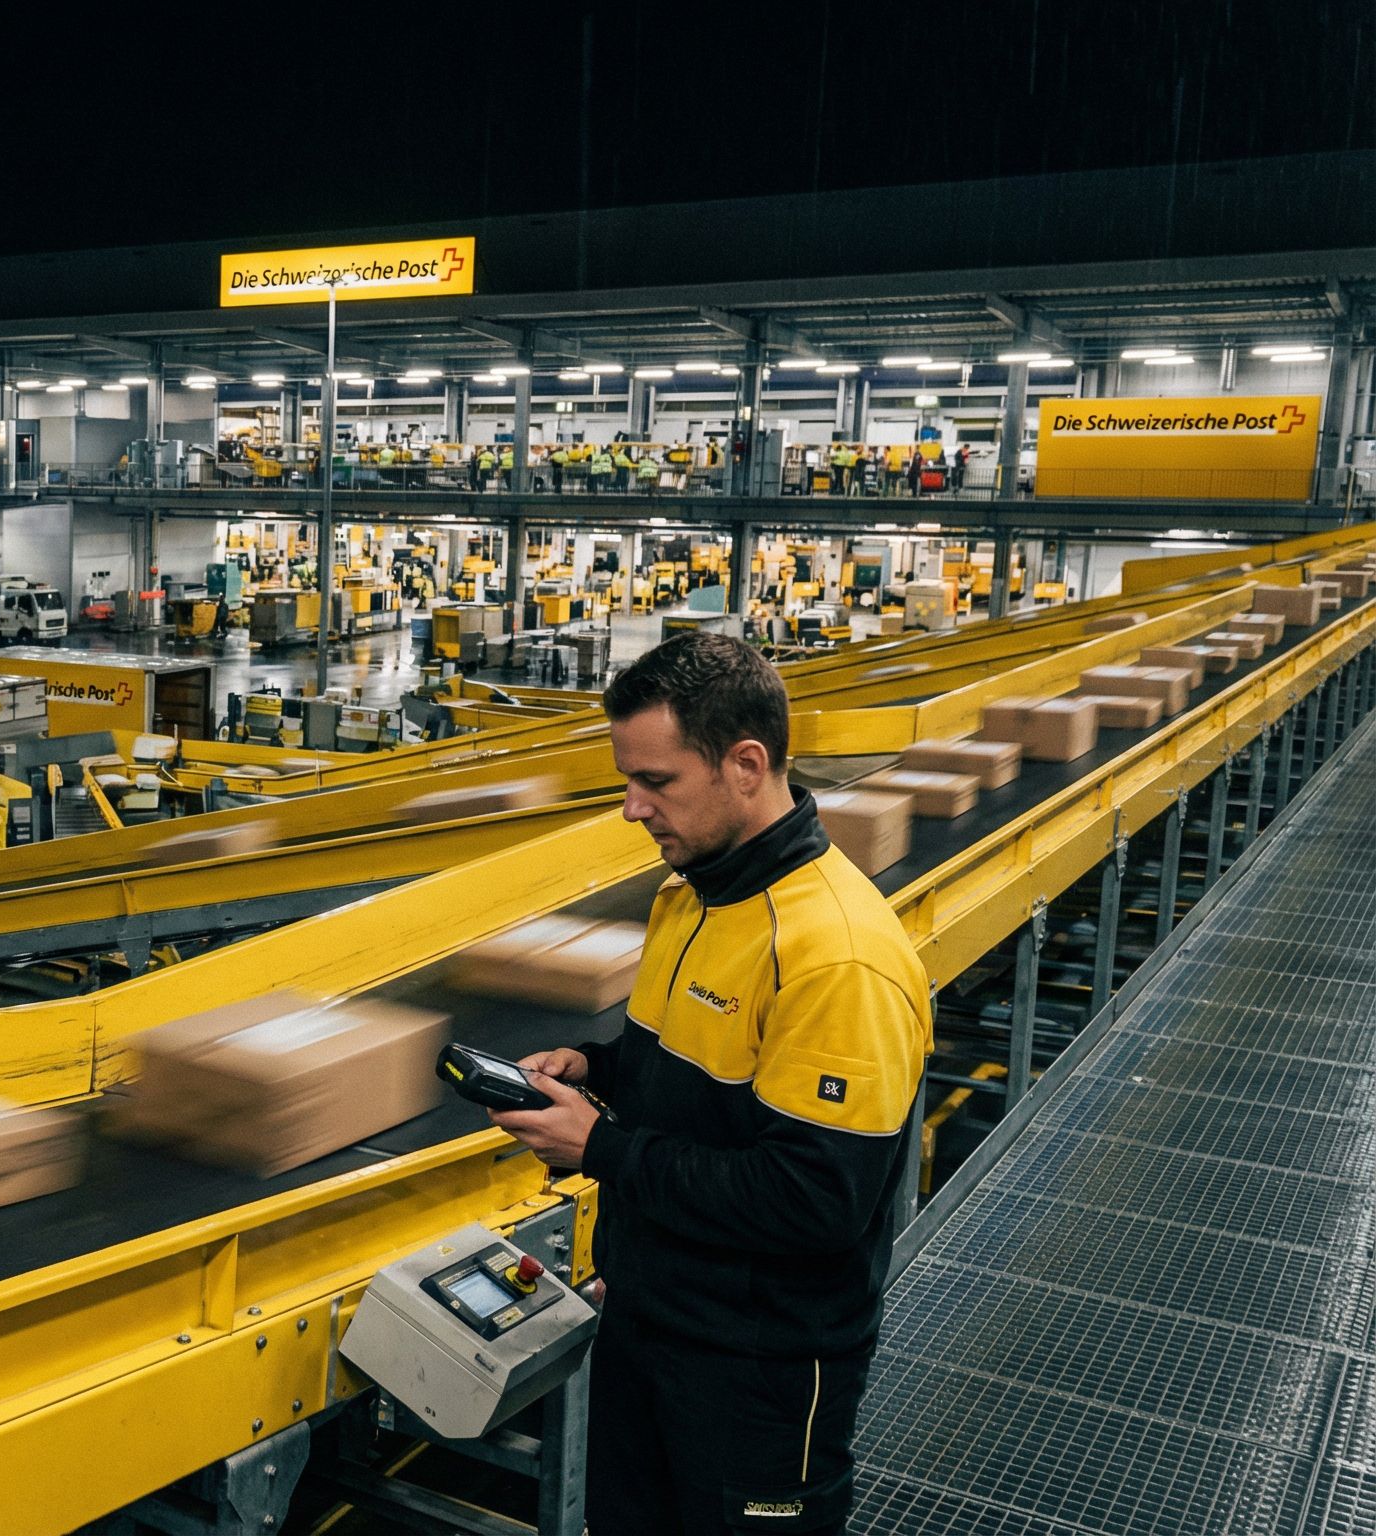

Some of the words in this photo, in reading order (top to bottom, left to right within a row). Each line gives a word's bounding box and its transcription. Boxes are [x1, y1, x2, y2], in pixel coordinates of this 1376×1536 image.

[231, 270, 258, 289] Die
[397, 259, 439, 278] Post
[1053, 415, 1082, 431] Die
[1086, 413, 1229, 431] Schweizerische
[1232, 413, 1278, 430] Post
[87, 684, 116, 701] Post
